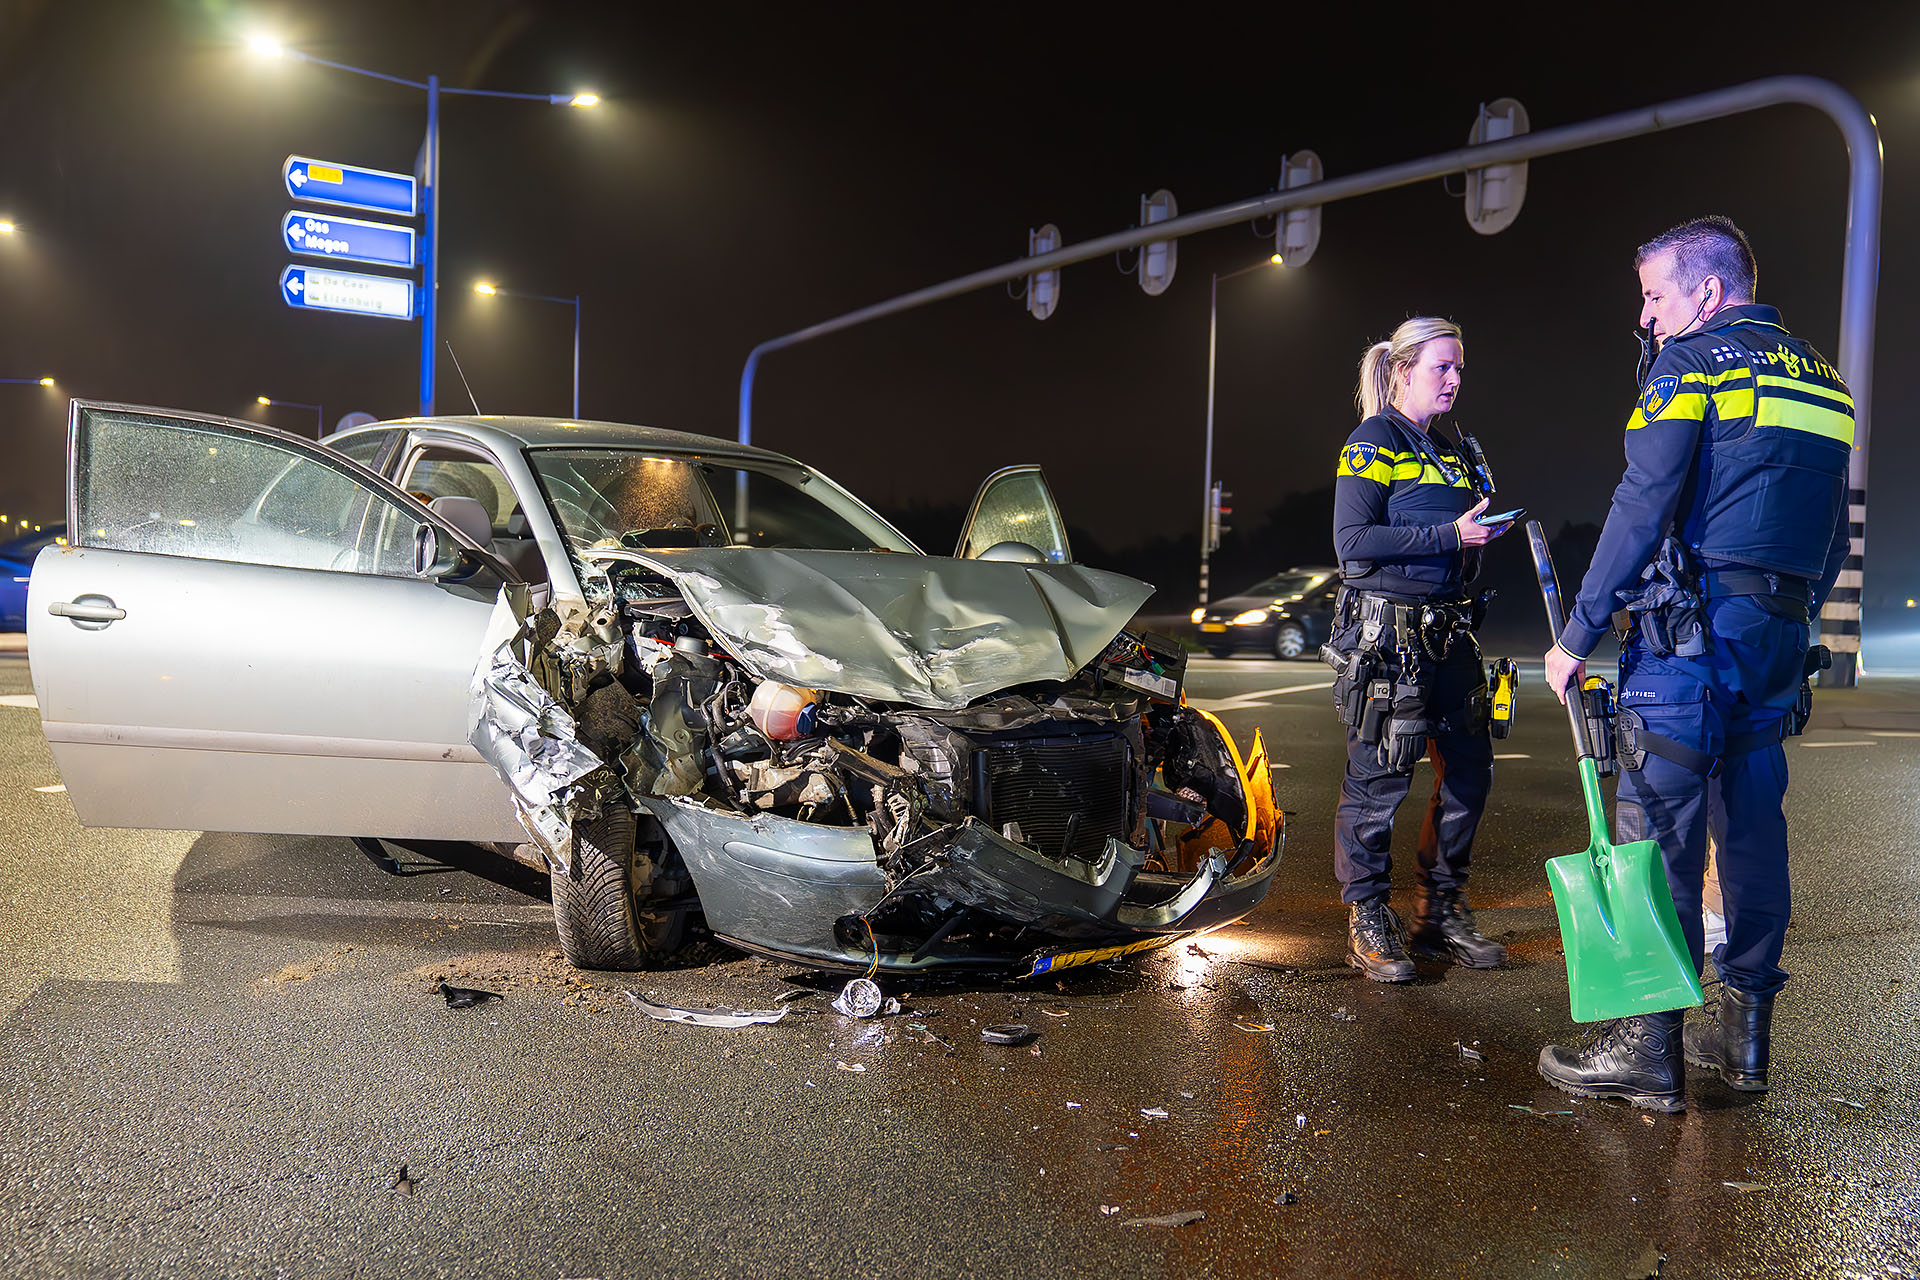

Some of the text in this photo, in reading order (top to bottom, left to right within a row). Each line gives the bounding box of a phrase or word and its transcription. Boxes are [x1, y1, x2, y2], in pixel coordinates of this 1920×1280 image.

[305, 218, 330, 234] Oss
[1646, 381, 1674, 396] POLITIE
[1350, 445, 1375, 454] POLITIE
